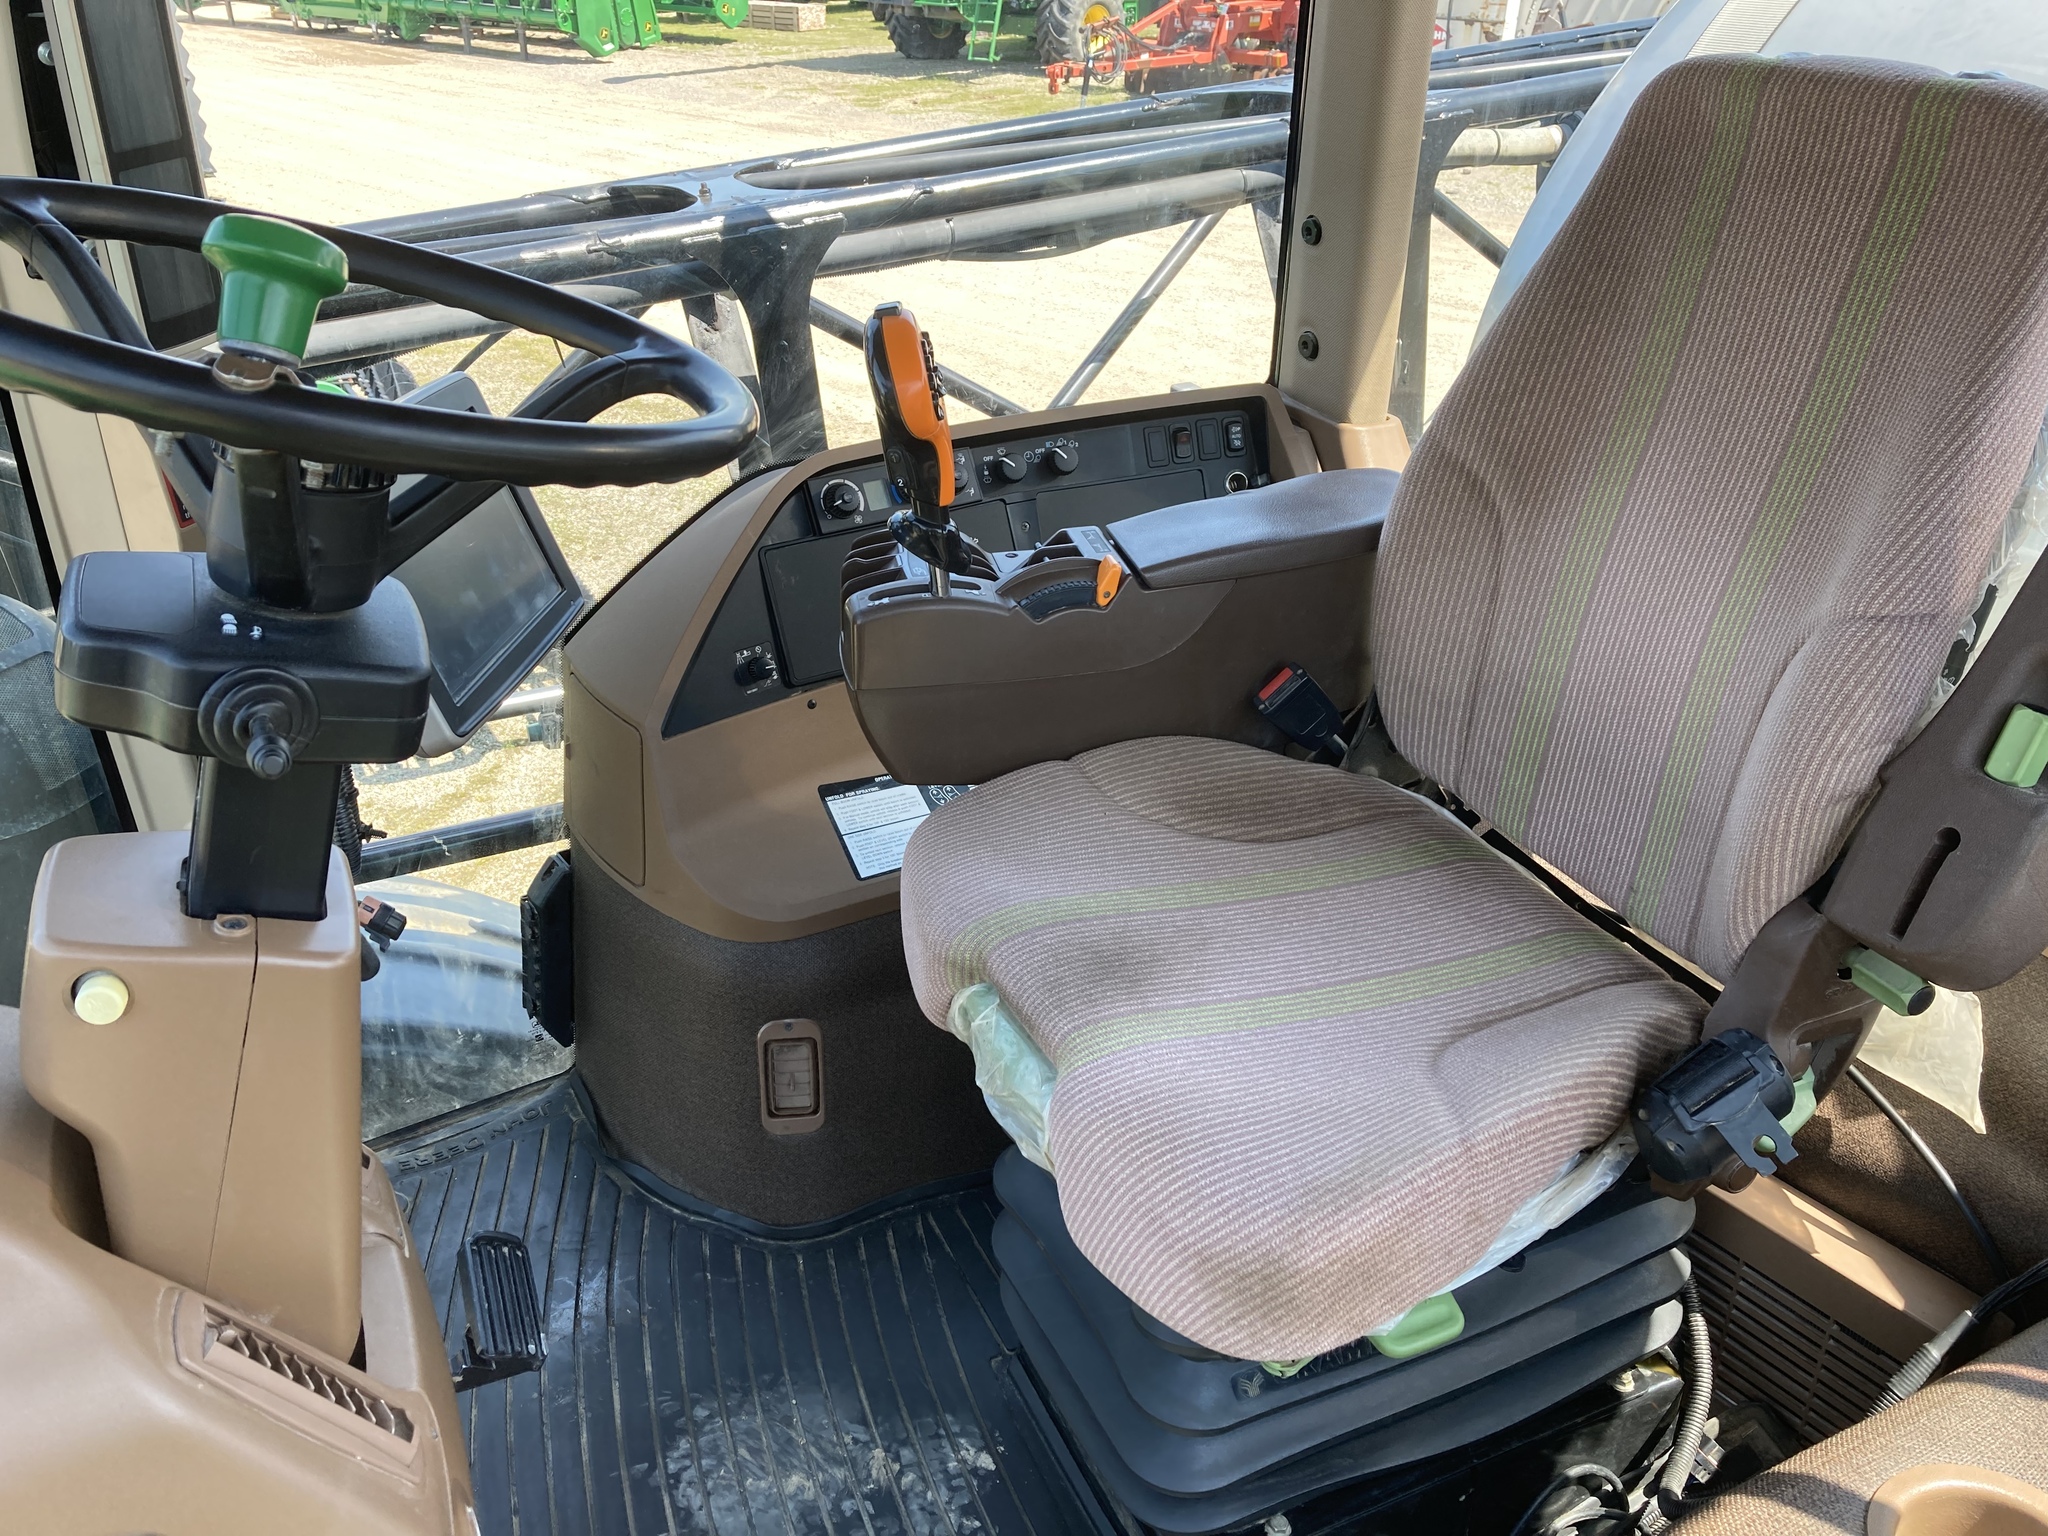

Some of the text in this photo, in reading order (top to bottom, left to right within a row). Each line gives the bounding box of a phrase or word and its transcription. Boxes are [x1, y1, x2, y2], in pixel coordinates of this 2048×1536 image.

[897, 478, 905, 487] 2
[398, 1100, 552, 1173] JOHN DEERE
